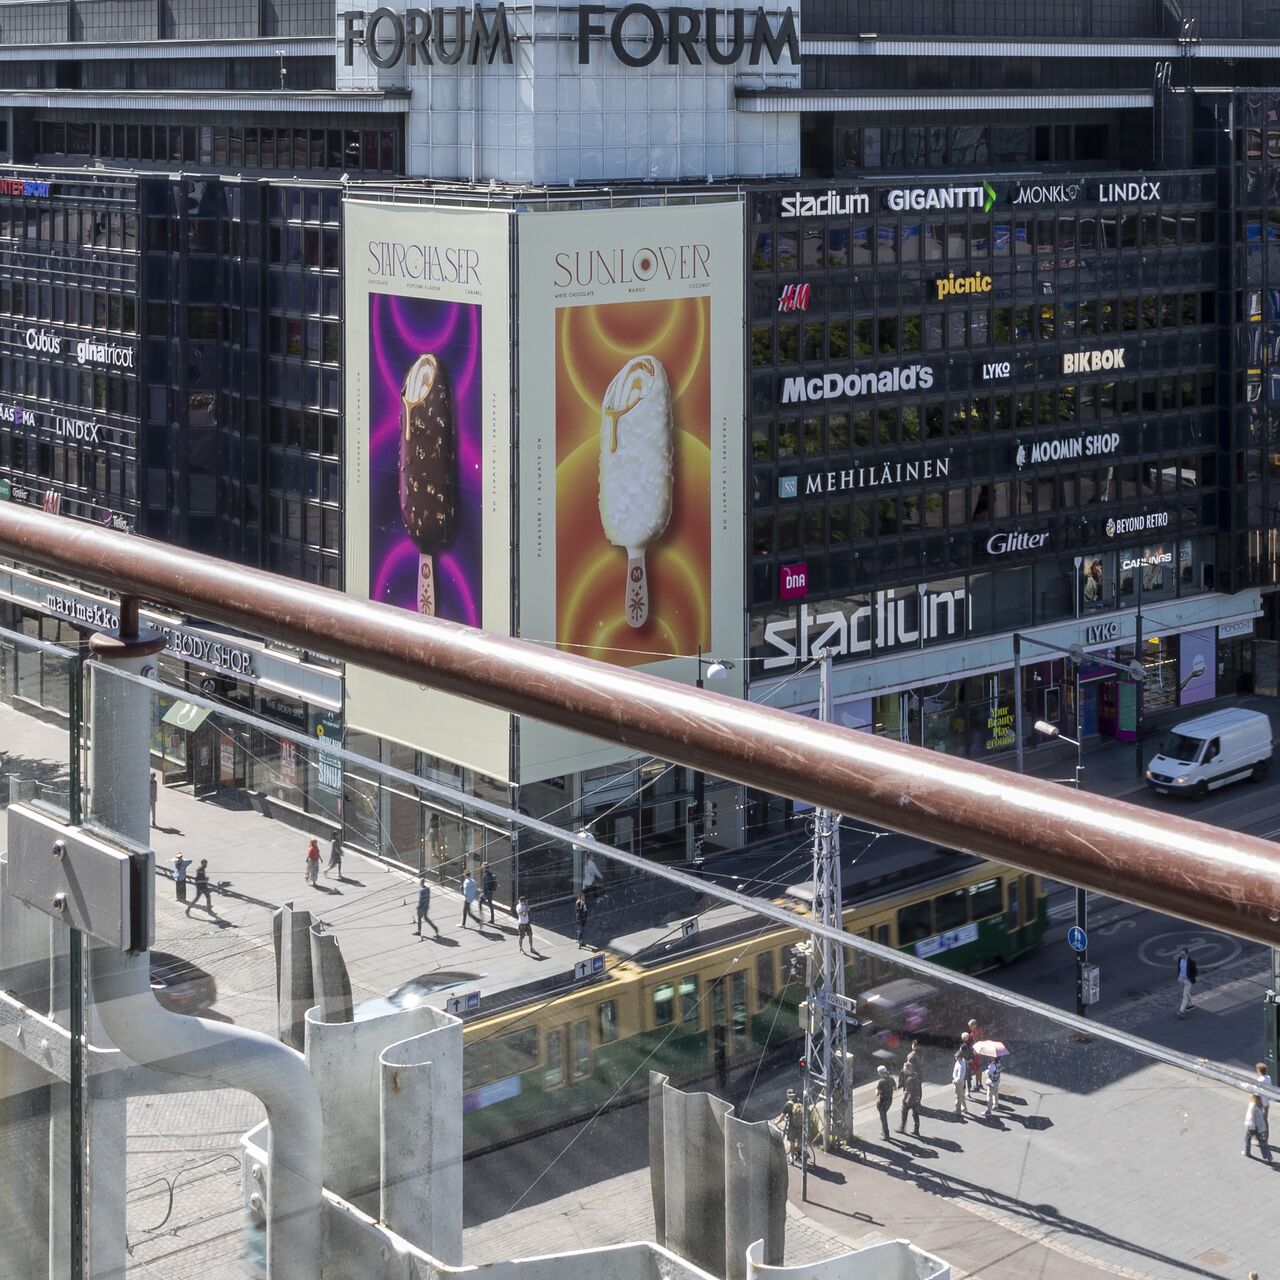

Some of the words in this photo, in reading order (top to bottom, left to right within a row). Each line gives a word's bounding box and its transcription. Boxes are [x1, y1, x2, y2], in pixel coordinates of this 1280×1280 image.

[343, 1, 514, 69] FORUM
[577, 2, 802, 67] FORUM
[781, 189, 869, 217] stadium
[887, 186, 985, 211] GIGANTTI
[1099, 182, 1161, 202] LINDEX
[367, 240, 482, 286] STARCHASER
[554, 243, 711, 288] SUNLOVER
[568, 290, 594, 298] CHOCOLATE
[936, 271, 992, 300] picnic
[25, 328, 61, 354] Cubus
[983, 361, 1010, 380] LYKO
[782, 365, 934, 403] McDonald's
[56, 418, 100, 443] LINDEX
[1031, 436, 1083, 464] MOOMIN
[1085, 433, 1120, 455] SHOP
[805, 457, 950, 494] MEHILÄINEN
[1116, 516, 1144, 534] BEYOND
[1146, 512, 1168, 527] RETRO
[986, 531, 1050, 556] Glitter
[1122, 552, 1172, 570] CARLINGS
[786, 574, 805, 589] DNA
[46, 594, 119, 629] marimekko
[763, 588, 973, 669] stadium
[1086, 622, 1118, 644] LYKO
[176, 633, 214, 664] BODY
[987, 715, 1014, 728] Beauty
[991, 707, 1009, 717] Your
[827, 994, 848, 1008] FORUM
